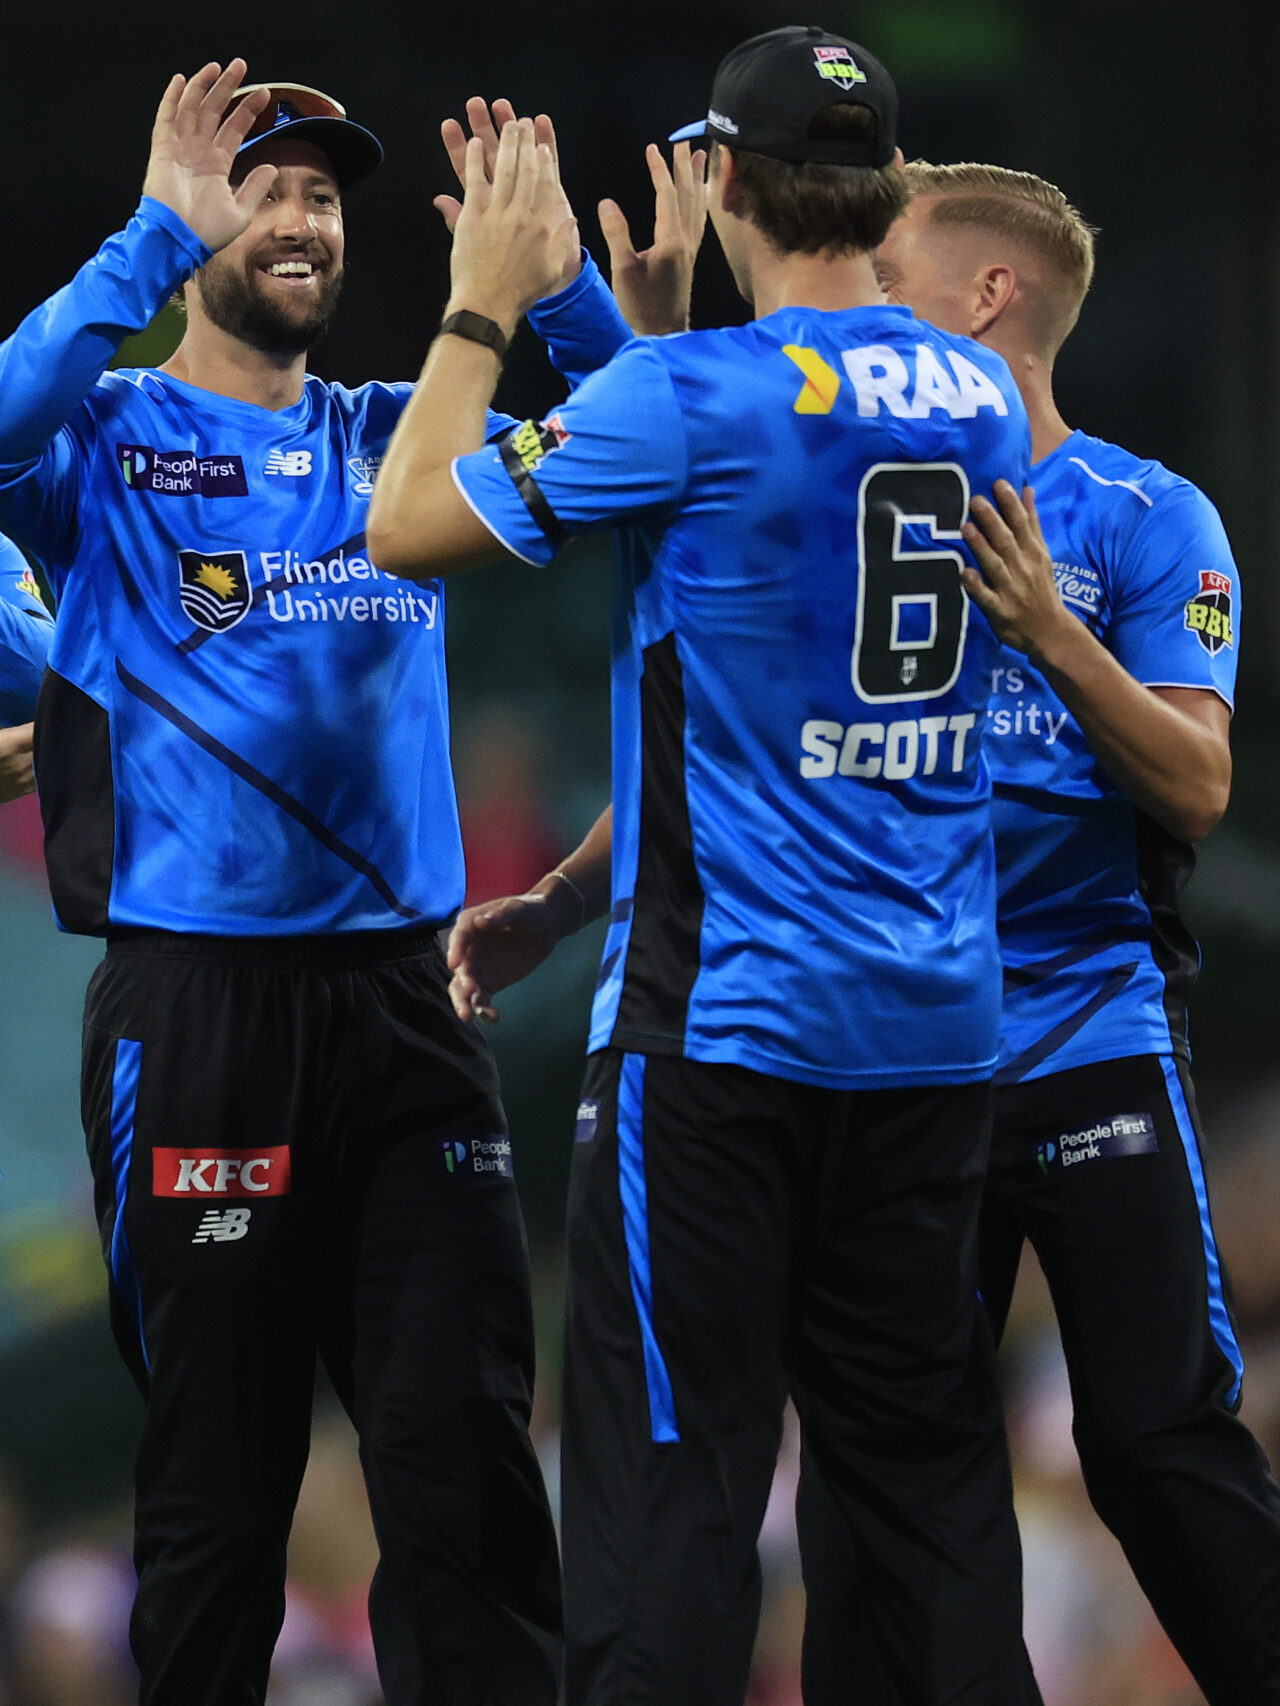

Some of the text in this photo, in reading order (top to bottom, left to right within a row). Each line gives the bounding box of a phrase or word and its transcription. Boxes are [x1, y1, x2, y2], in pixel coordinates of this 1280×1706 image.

[820, 63, 865, 79] BBL
[841, 344, 1009, 419] RAA
[153, 454, 236, 477] Peopl First
[152, 472, 193, 491] Bank
[260, 549, 398, 584] Flinde
[1052, 562, 1098, 582] DELAIDE
[851, 462, 970, 704] 6
[1207, 573, 1229, 592] KFC
[266, 588, 437, 630] University
[1188, 603, 1233, 645] BBL
[800, 713, 976, 780] SCOTT
[1060, 1119, 1147, 1150] People First
[474, 1157, 506, 1172] Bank
[1062, 1144, 1101, 1166] Bank
[173, 1158, 271, 1192] KFC
